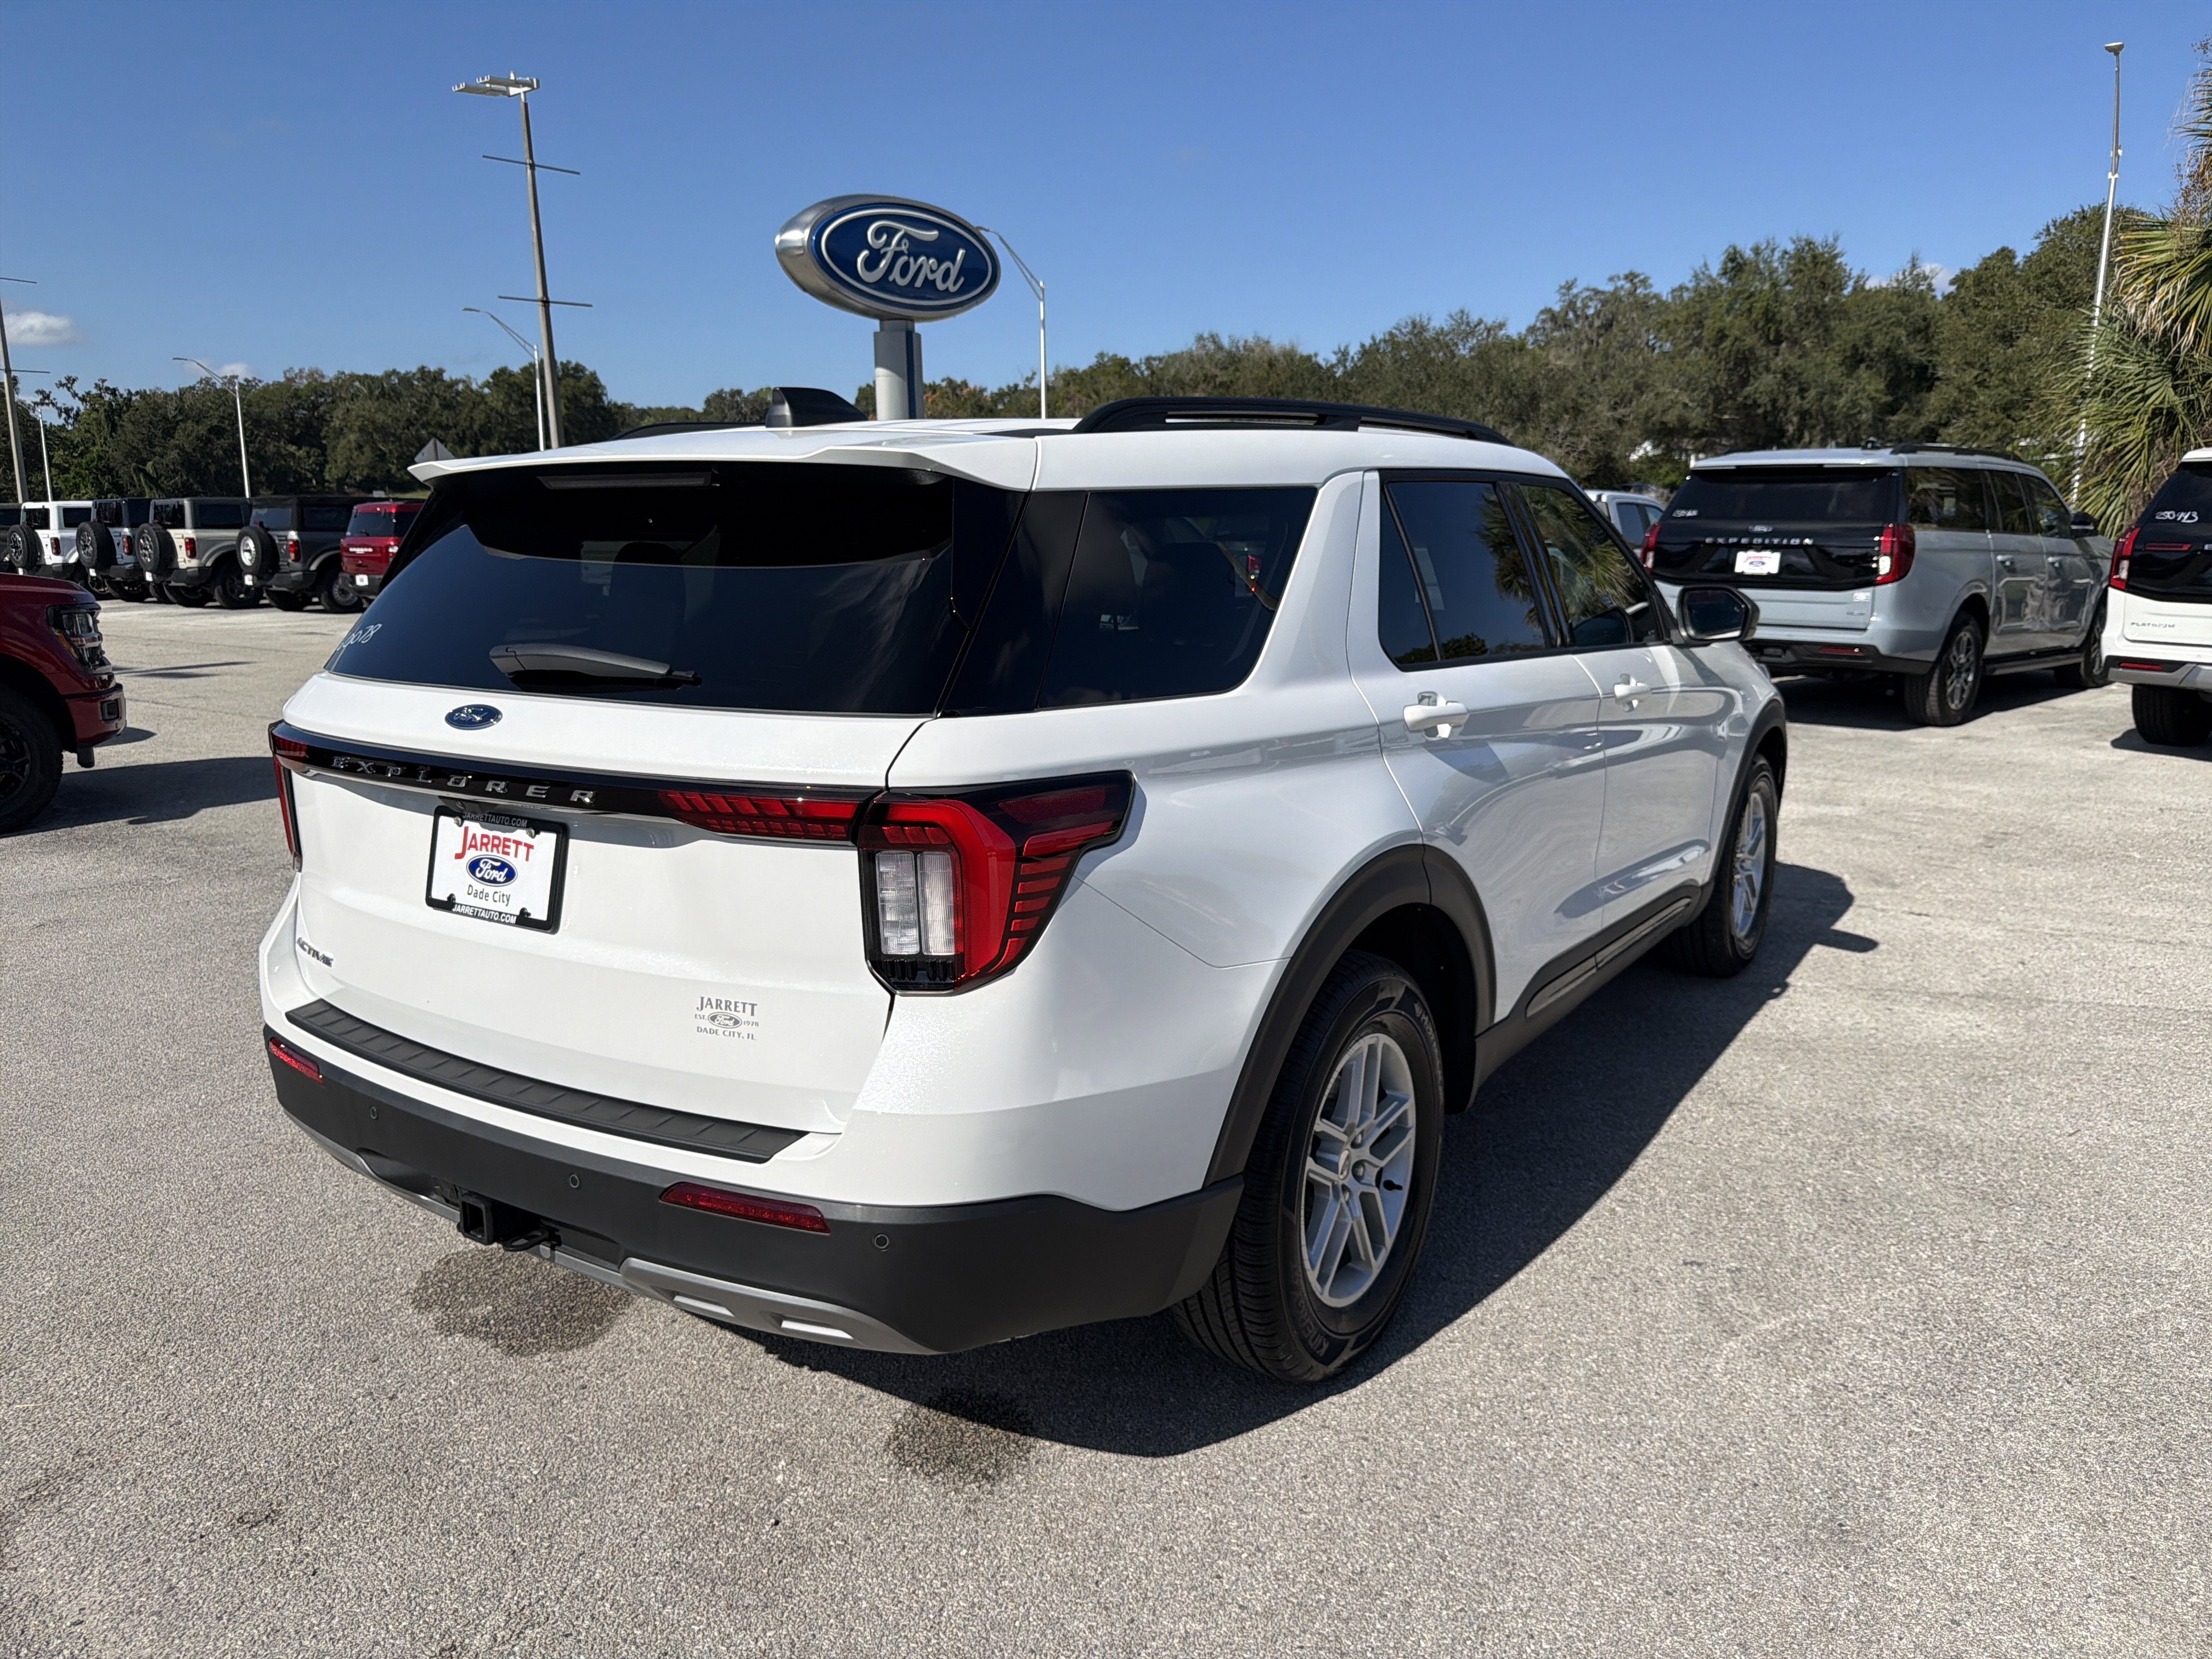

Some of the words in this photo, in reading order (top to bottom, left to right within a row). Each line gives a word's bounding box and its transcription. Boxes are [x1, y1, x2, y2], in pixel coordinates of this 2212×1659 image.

[856, 220, 966, 293] Ford
[332, 755, 597, 805] EXPLORER
[462, 811, 528, 827] JARRETTAUTO.COM
[454, 826, 534, 862] JARRETT
[475, 858, 509, 883] Ford
[467, 884, 489, 902] Dade
[493, 891, 511, 907] City
[452, 904, 517, 924] JARRETTAUTO.COM
[297, 936, 334, 968] ACTIVE
[696, 996, 758, 1017] JARRETT
[714, 1014, 735, 1026] Ford
[696, 1026, 720, 1036] DADE
[723, 1030, 745, 1040] CITY,
[747, 1032, 756, 1041] FL
